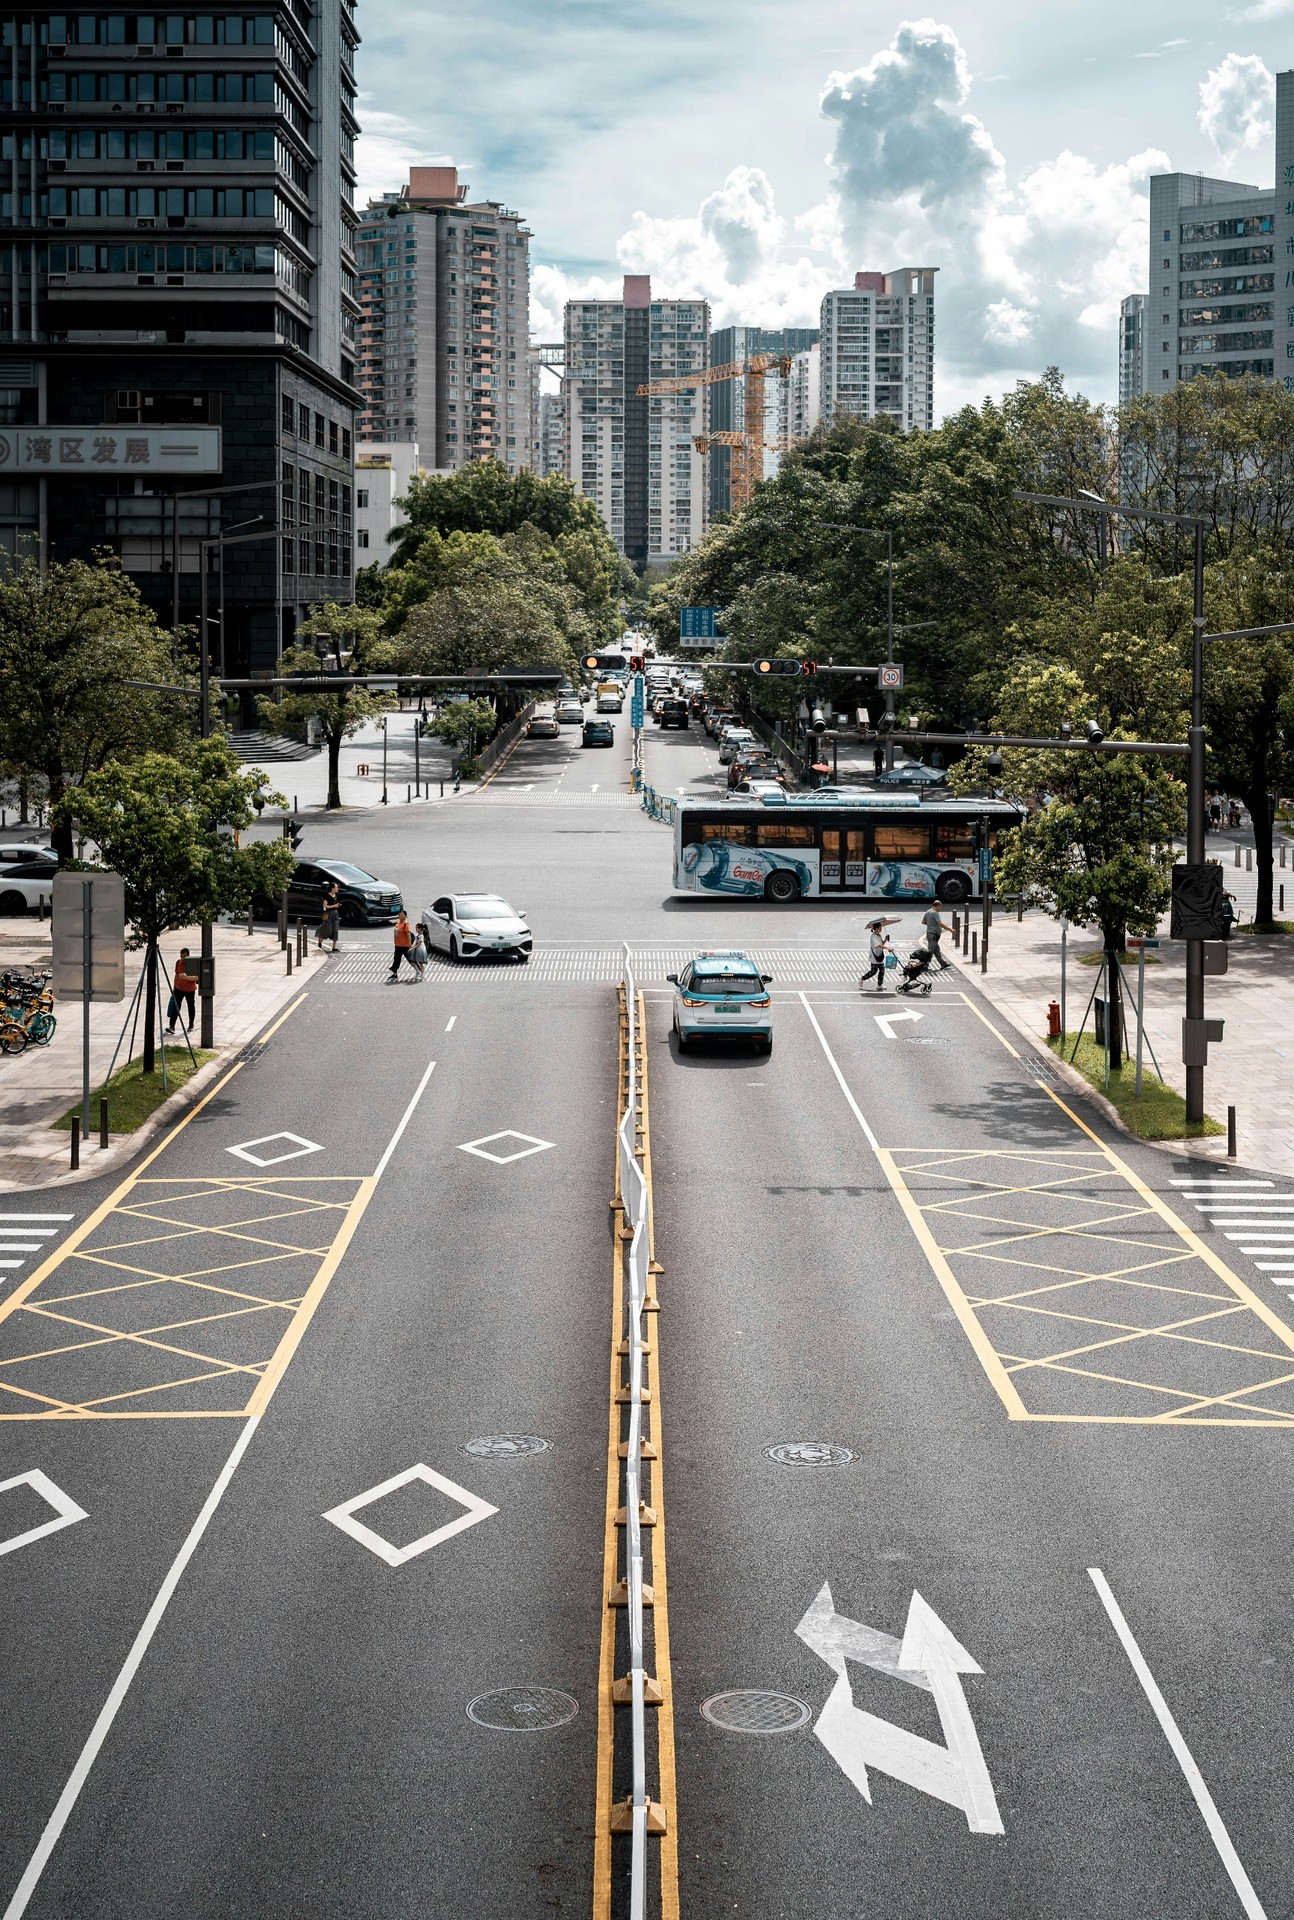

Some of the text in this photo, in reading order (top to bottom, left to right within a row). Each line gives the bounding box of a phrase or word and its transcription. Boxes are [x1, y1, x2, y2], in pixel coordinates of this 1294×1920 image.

[26, 436, 150, 464] 湾区发展
[631, 657, 644, 671] 57
[803, 661, 816, 675] 57
[886, 673, 896, 681] 30
